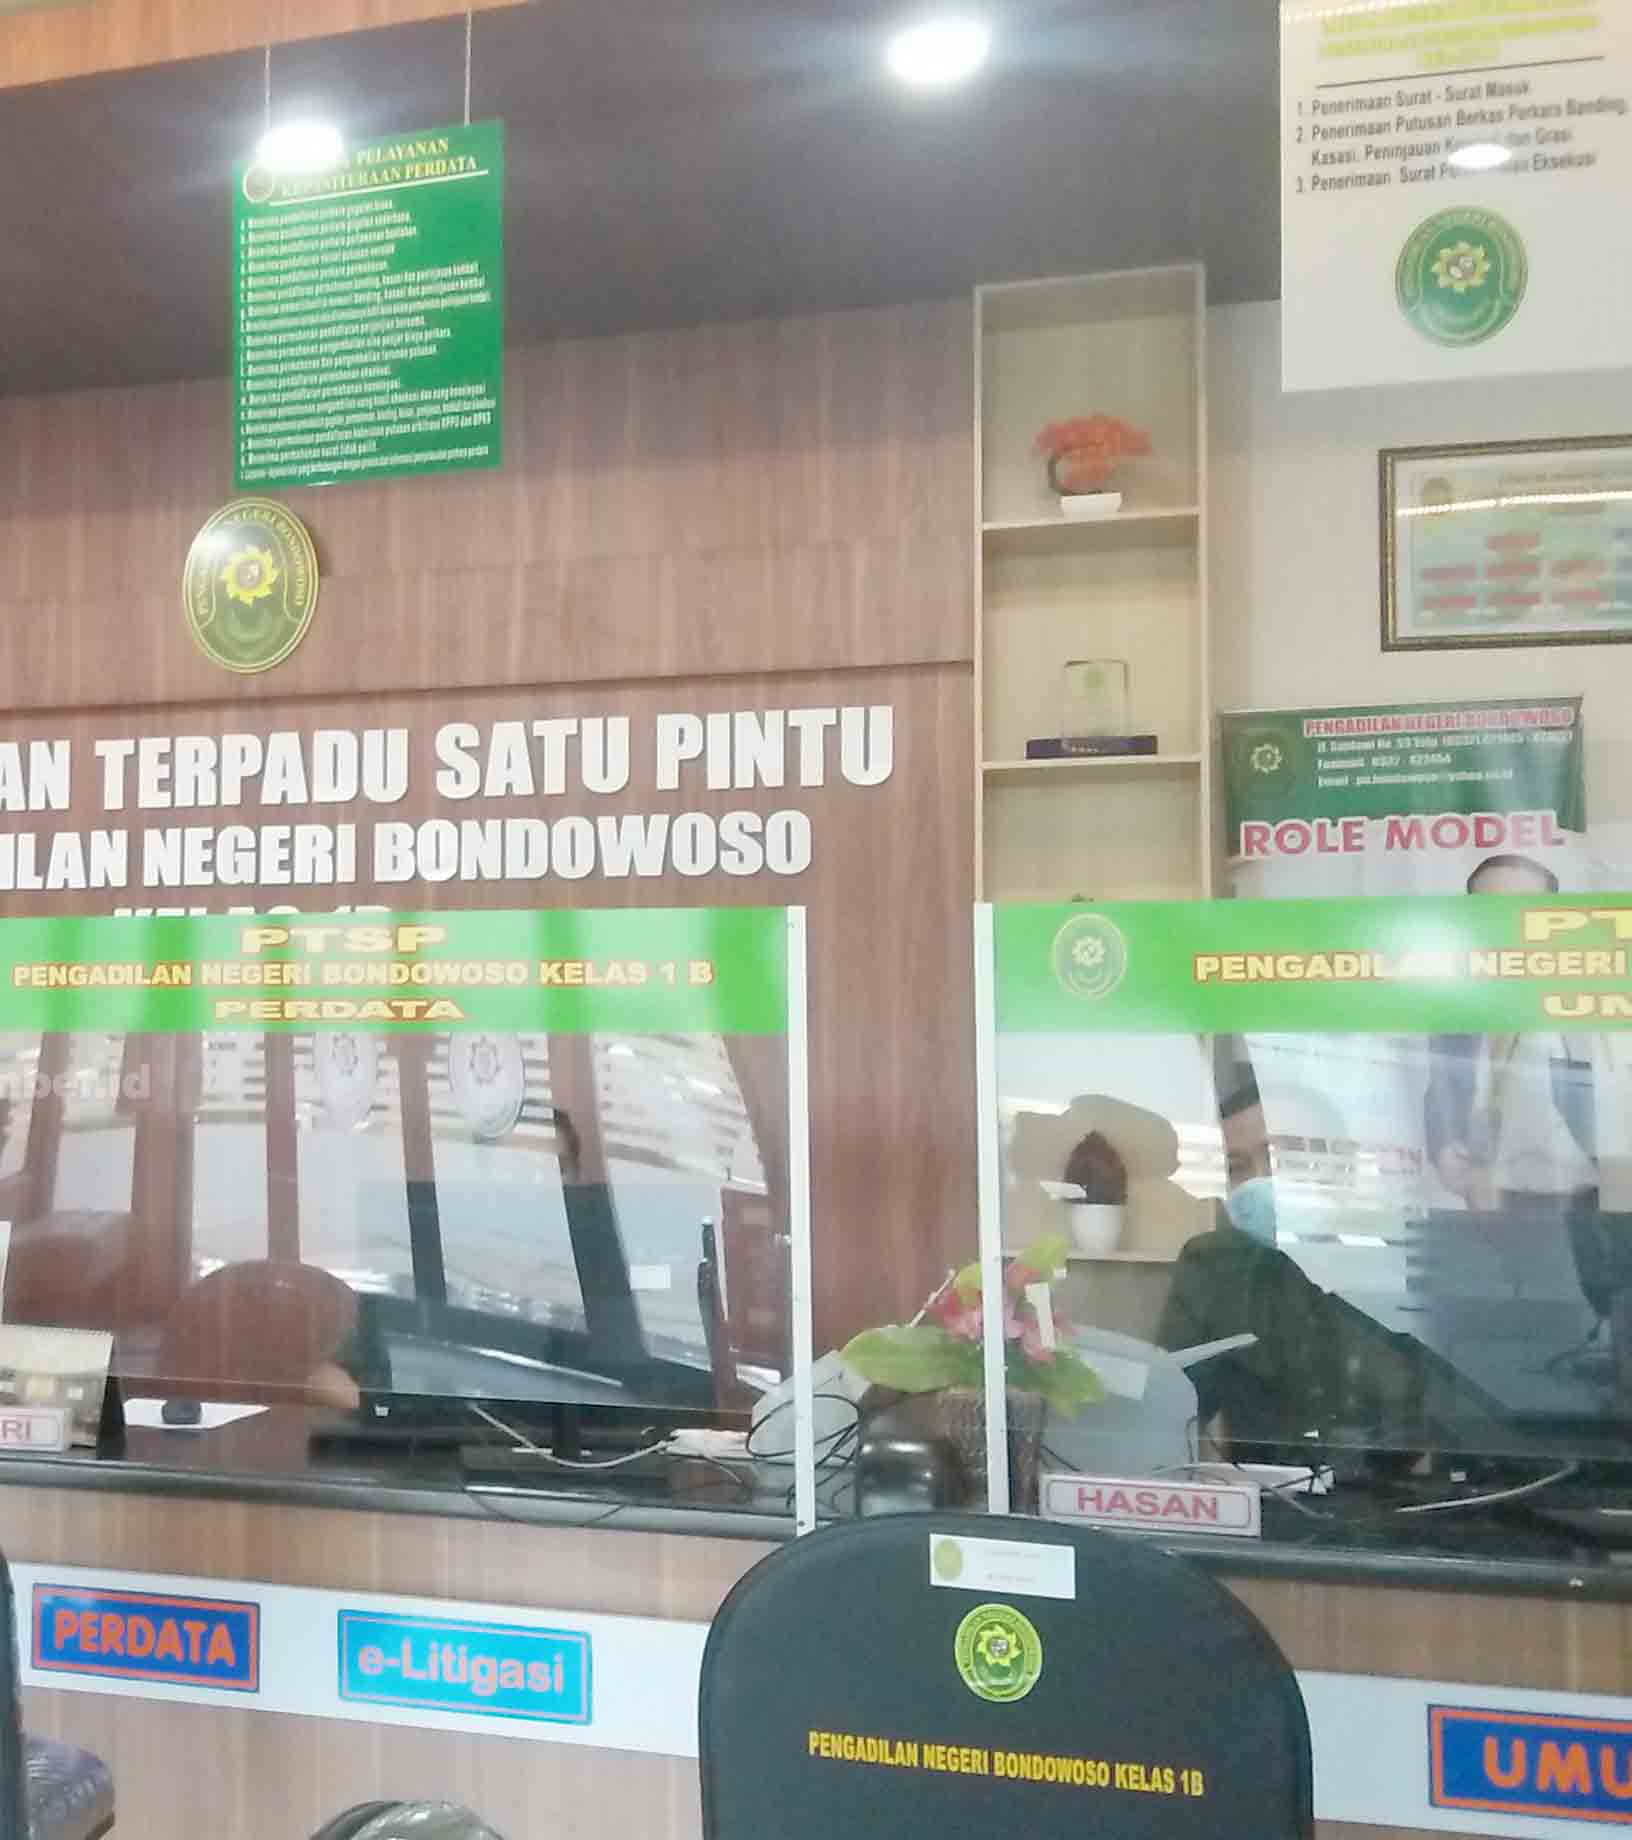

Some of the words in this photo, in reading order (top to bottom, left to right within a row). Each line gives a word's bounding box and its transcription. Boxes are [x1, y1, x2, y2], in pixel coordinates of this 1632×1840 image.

[1312, 95, 1393, 116] Penerimaan
[1395, 89, 1433, 107] Surat
[1312, 122, 1392, 142] Penerimaan
[404, 156, 477, 179] PERDATA
[1312, 170, 1392, 192] Penerimaan
[95, 728, 409, 811] TERPADU
[435, 715, 631, 800] SATU
[656, 705, 894, 791] PINTU
[143, 823, 357, 887] NEGERI
[374, 809, 812, 883] BONDOWOSO
[1240, 820, 1366, 857] ROLE
[1383, 809, 1566, 853] MODEL
[240, 925, 448, 953] PTSP
[13, 961, 192, 987] PENGADILAN
[200, 963, 313, 986] NEGERI
[320, 960, 528, 986] BONDOWOSO
[539, 960, 649, 986] KELAS
[659, 961, 676, 985] 1
[688, 959, 714, 985] B
[1195, 953, 1463, 981] PENGADIL
[1471, 951, 1626, 977] NEGERI
[212, 1000, 465, 1020] PERDATA
[1077, 1487, 1217, 1521] HASAN
[55, 1610, 236, 1667] PERDATA
[358, 1641, 564, 1694] e-Litigasi
[808, 1731, 918, 1768] PENGADILAN
[923, 1744, 988, 1775] NEGERI
[993, 1751, 1110, 1788] BONDOWOSO
[1114, 1763, 1175, 1795] KELAS
[1180, 1768, 1204, 1797] 1B
